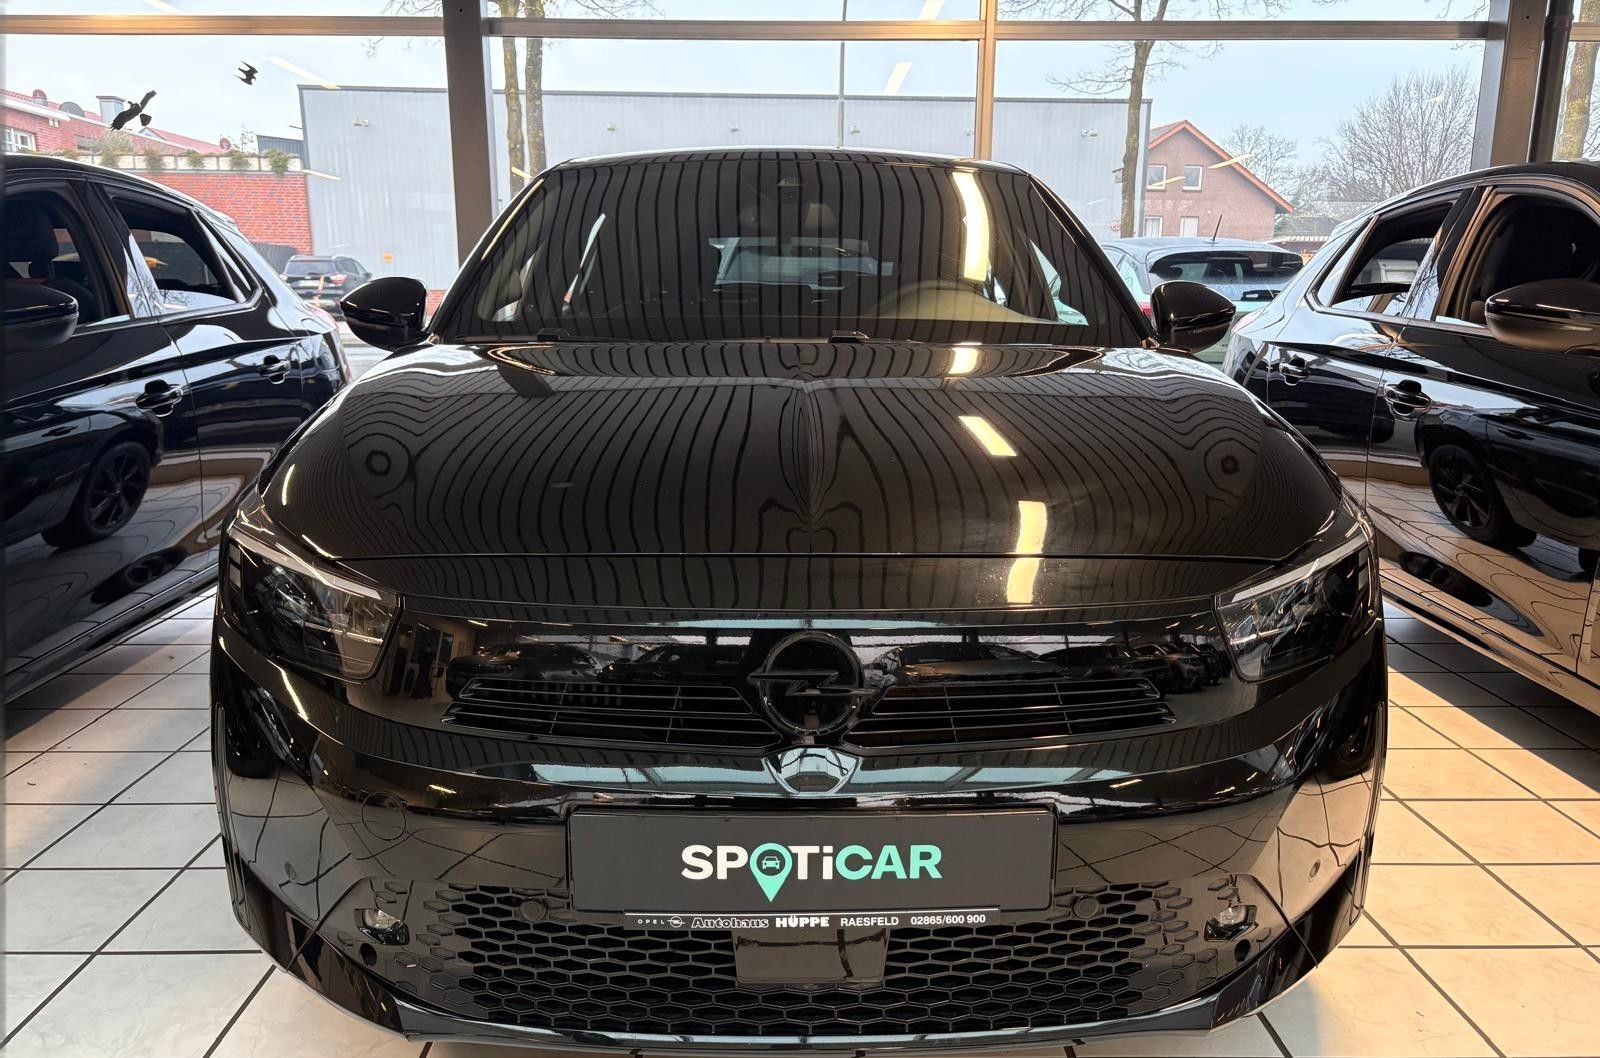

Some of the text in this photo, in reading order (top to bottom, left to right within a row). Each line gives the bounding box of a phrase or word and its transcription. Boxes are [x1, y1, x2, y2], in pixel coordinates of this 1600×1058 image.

[691, 917, 769, 929] Autohaus
[775, 914, 829, 928] HÜPPE
[840, 916, 899, 927] RAESFELD
[910, 915, 964, 926] 02865/600
[967, 914, 986, 925] 900
